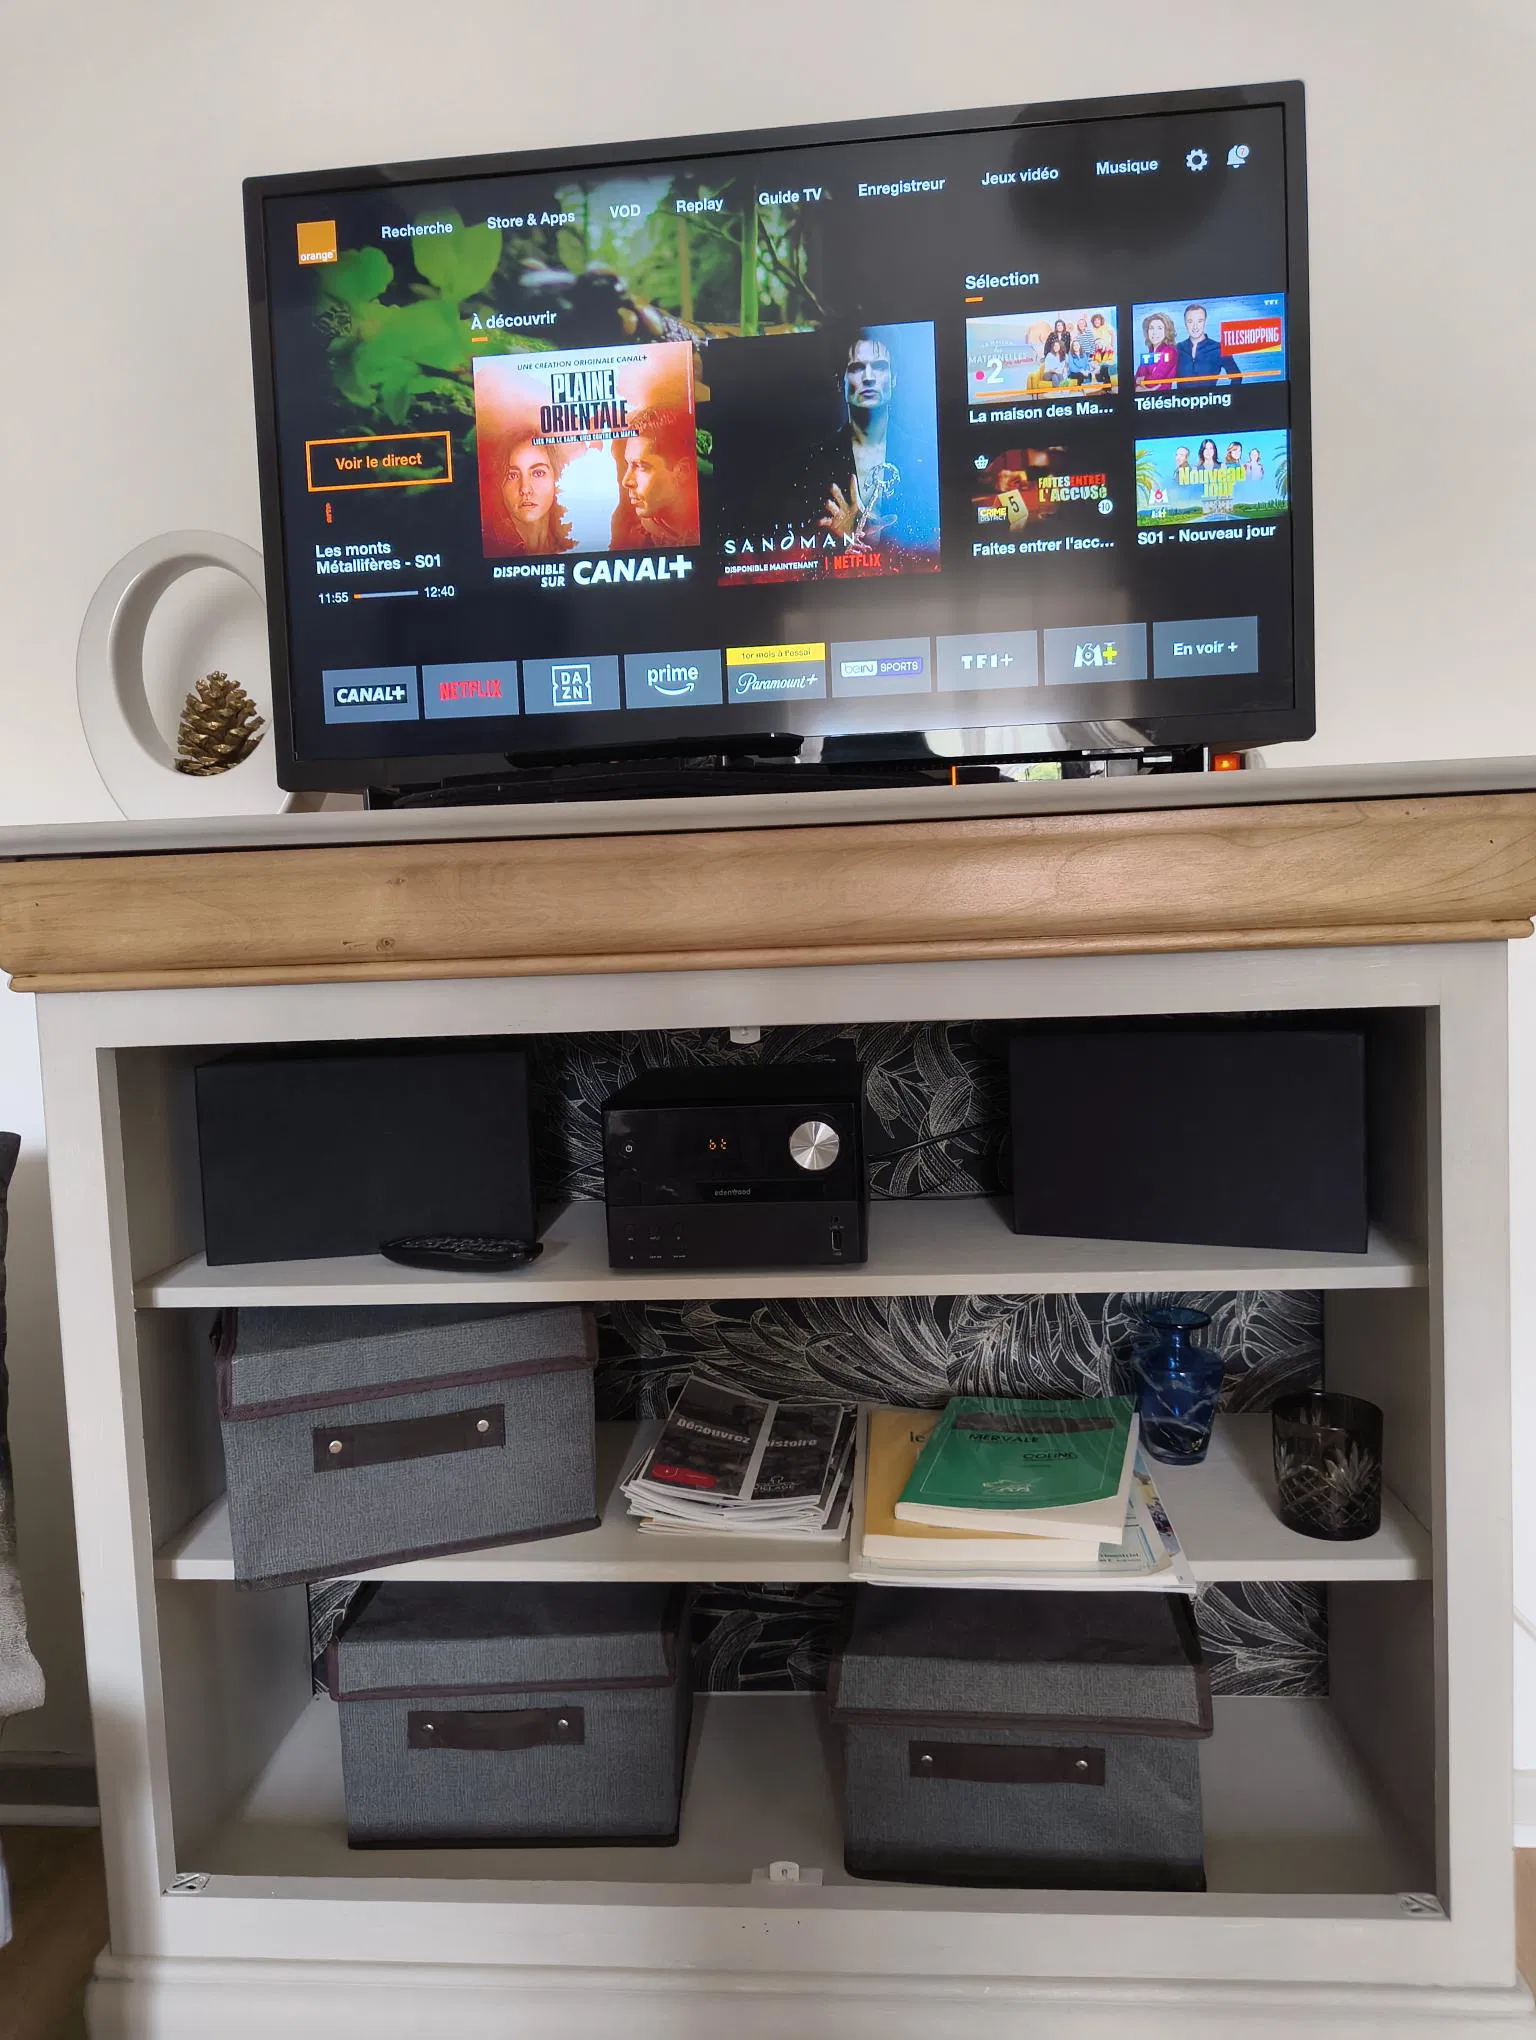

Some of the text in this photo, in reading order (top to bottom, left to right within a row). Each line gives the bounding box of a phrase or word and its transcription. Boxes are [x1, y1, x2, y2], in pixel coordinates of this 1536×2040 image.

[981, 165, 1059, 185] Jeux vidéo
[1096, 158, 1158, 176] Musique
[758, 187, 823, 206] Guide TV
[858, 177, 946, 198] Enregistreur
[609, 203, 641, 219] VOD
[676, 197, 724, 217] Replay
[487, 210, 575, 230] Store & Apps
[381, 221, 453, 239] Recherche
[300, 250, 334, 262] orange
[965, 270, 1039, 290] Sélection
[471, 310, 557, 330] À découvrir
[517, 362, 533, 371] UNE
[573, 357, 614, 367] ORIGINALE
[616, 354, 648, 364] CANAL+
[987, 358, 1004, 383] 2
[552, 370, 614, 403] PLAINE
[1135, 392, 1232, 411] Téléshopping
[540, 400, 629, 433] ORIENTALE
[969, 401, 1114, 424] La maison des Ma...
[335, 452, 423, 471] Voir le direct
[980, 507, 1007, 517] CRIME
[1008, 496, 1020, 513] 5
[1137, 531, 1164, 546] S01
[1178, 527, 1243, 543] Nouveau
[1246, 524, 1277, 541] jour
[315, 541, 391, 558] Les monts
[973, 536, 1115, 557] Faites entrer l'acc...
[316, 557, 401, 574] Métallifères
[414, 553, 441, 569] S01
[493, 562, 566, 579] DISPONIBLE
[572, 553, 693, 585] CANAL+
[724, 553, 881, 574] DISPONIBLE MAINTENANT NETFLIX
[540, 573, 566, 589] SUR
[318, 592, 349, 604] 11:55
[424, 585, 455, 598] 12:40
[1173, 641, 1238, 656] En voir +
[880, 661, 918, 673] SPORTS
[961, 654, 1013, 670] TF1+
[560, 671, 582, 685] DA
[647, 663, 699, 686] prime
[736, 672, 818, 695] Paramount+
[336, 685, 406, 704] CANAL+
[439, 679, 503, 701] NETFLIX
[561, 685, 583, 699] ZN
[676, 1417, 752, 1444] Découvrez
